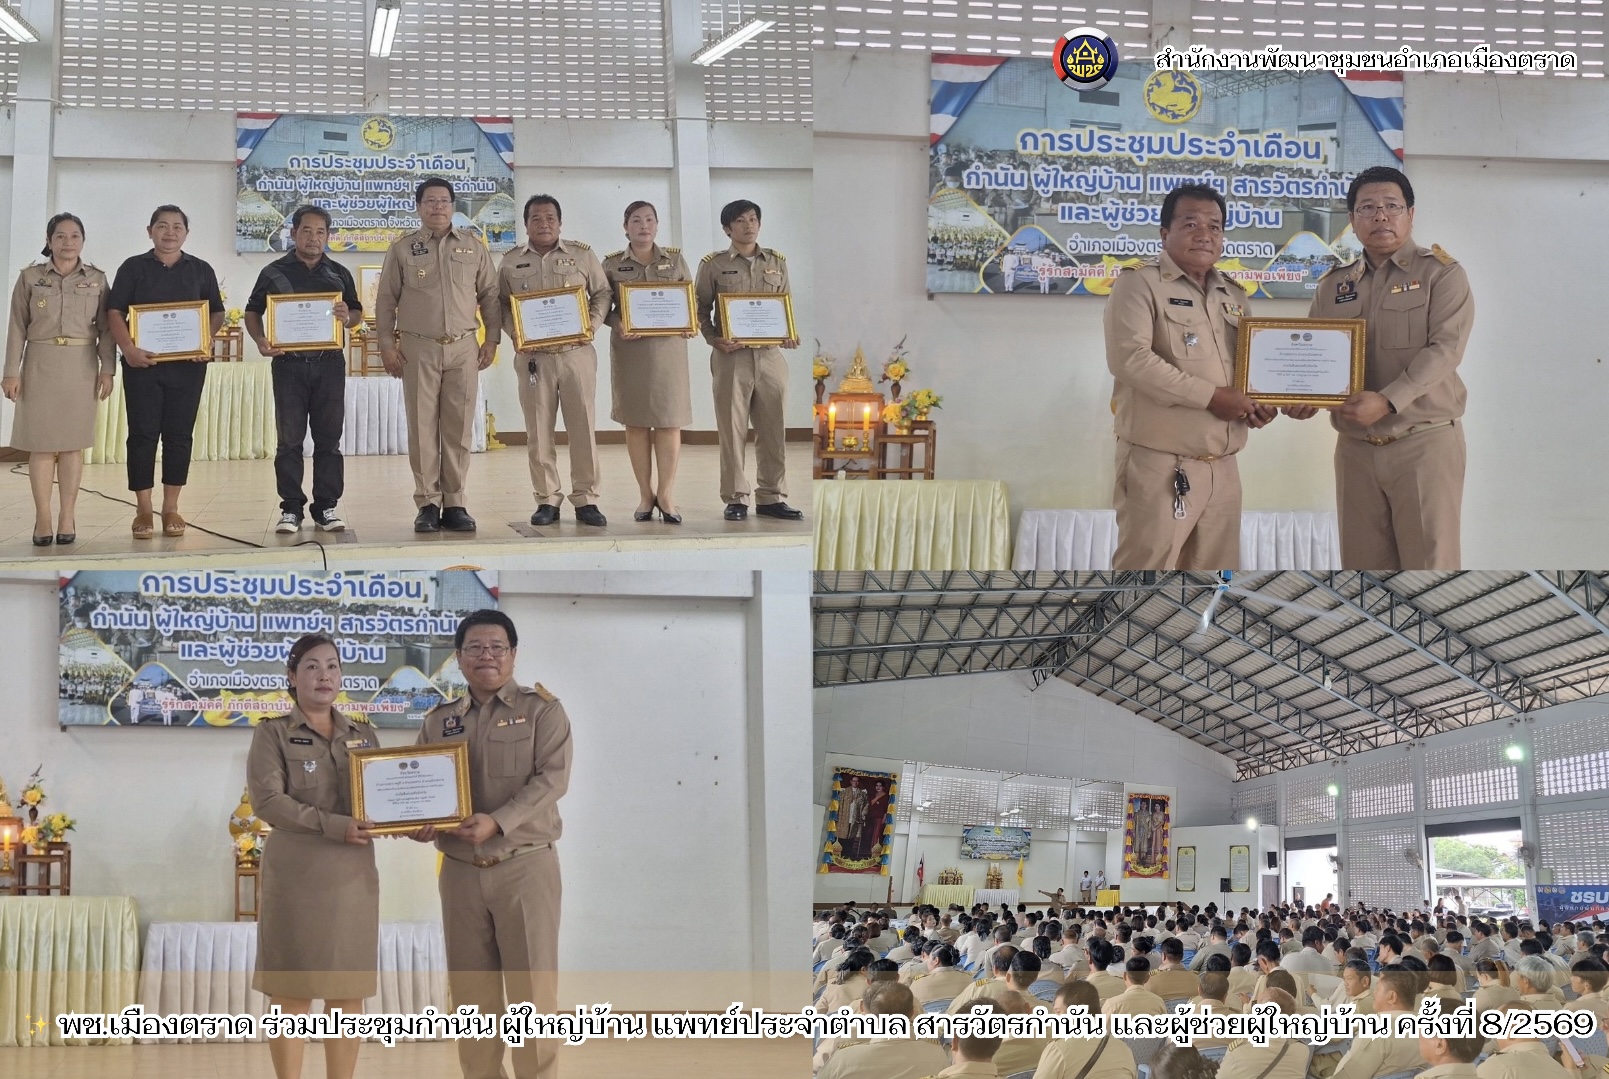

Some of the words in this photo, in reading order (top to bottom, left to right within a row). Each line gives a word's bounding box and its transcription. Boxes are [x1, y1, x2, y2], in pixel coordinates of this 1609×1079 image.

[1020, 129, 1321, 162] การประชุมประจำเดือน
[290, 154, 466, 174] การประชุมประจำเดือน
[258, 176, 293, 190] กำนัน
[298, 177, 360, 194] ผู้ใหญ่บ้าน
[365, 178, 410, 191] แพทย์ฯ
[965, 165, 1025, 188] กำนัน
[1033, 166, 1141, 194] ผู้ใหญ่บ้าน
[1233, 173, 1354, 197] สารวัตรกำนั
[314, 195, 416, 213] และผู้ช่วยผู้ใหญ่
[142, 572, 421, 602] การประชุมประจำเดือน
[93, 606, 148, 627] กำนัน
[156, 608, 254, 634] ผู้ใหญ่บ้าน
[263, 612, 332, 632] แพทย์ฯ
